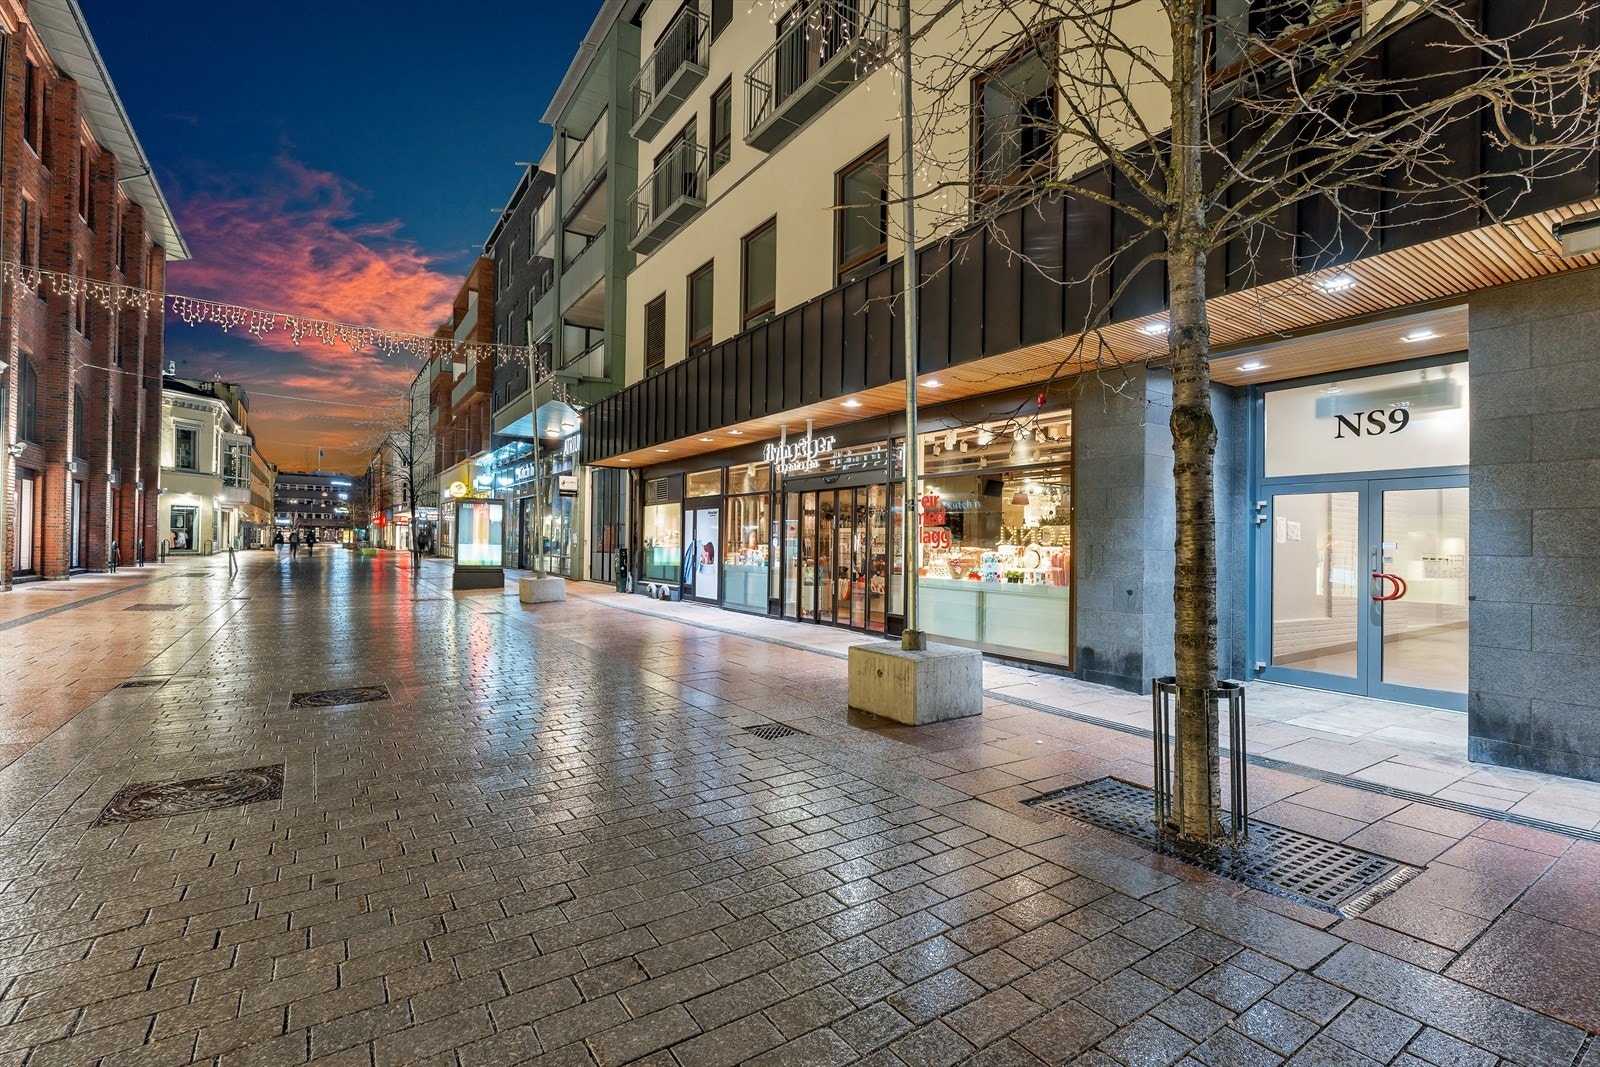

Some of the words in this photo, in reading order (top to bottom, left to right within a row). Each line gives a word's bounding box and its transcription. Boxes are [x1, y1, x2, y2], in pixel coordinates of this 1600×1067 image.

[1334, 408, 1409, 438] NS9
[763, 441, 797, 464] flying
[919, 527, 951, 549] lagg
